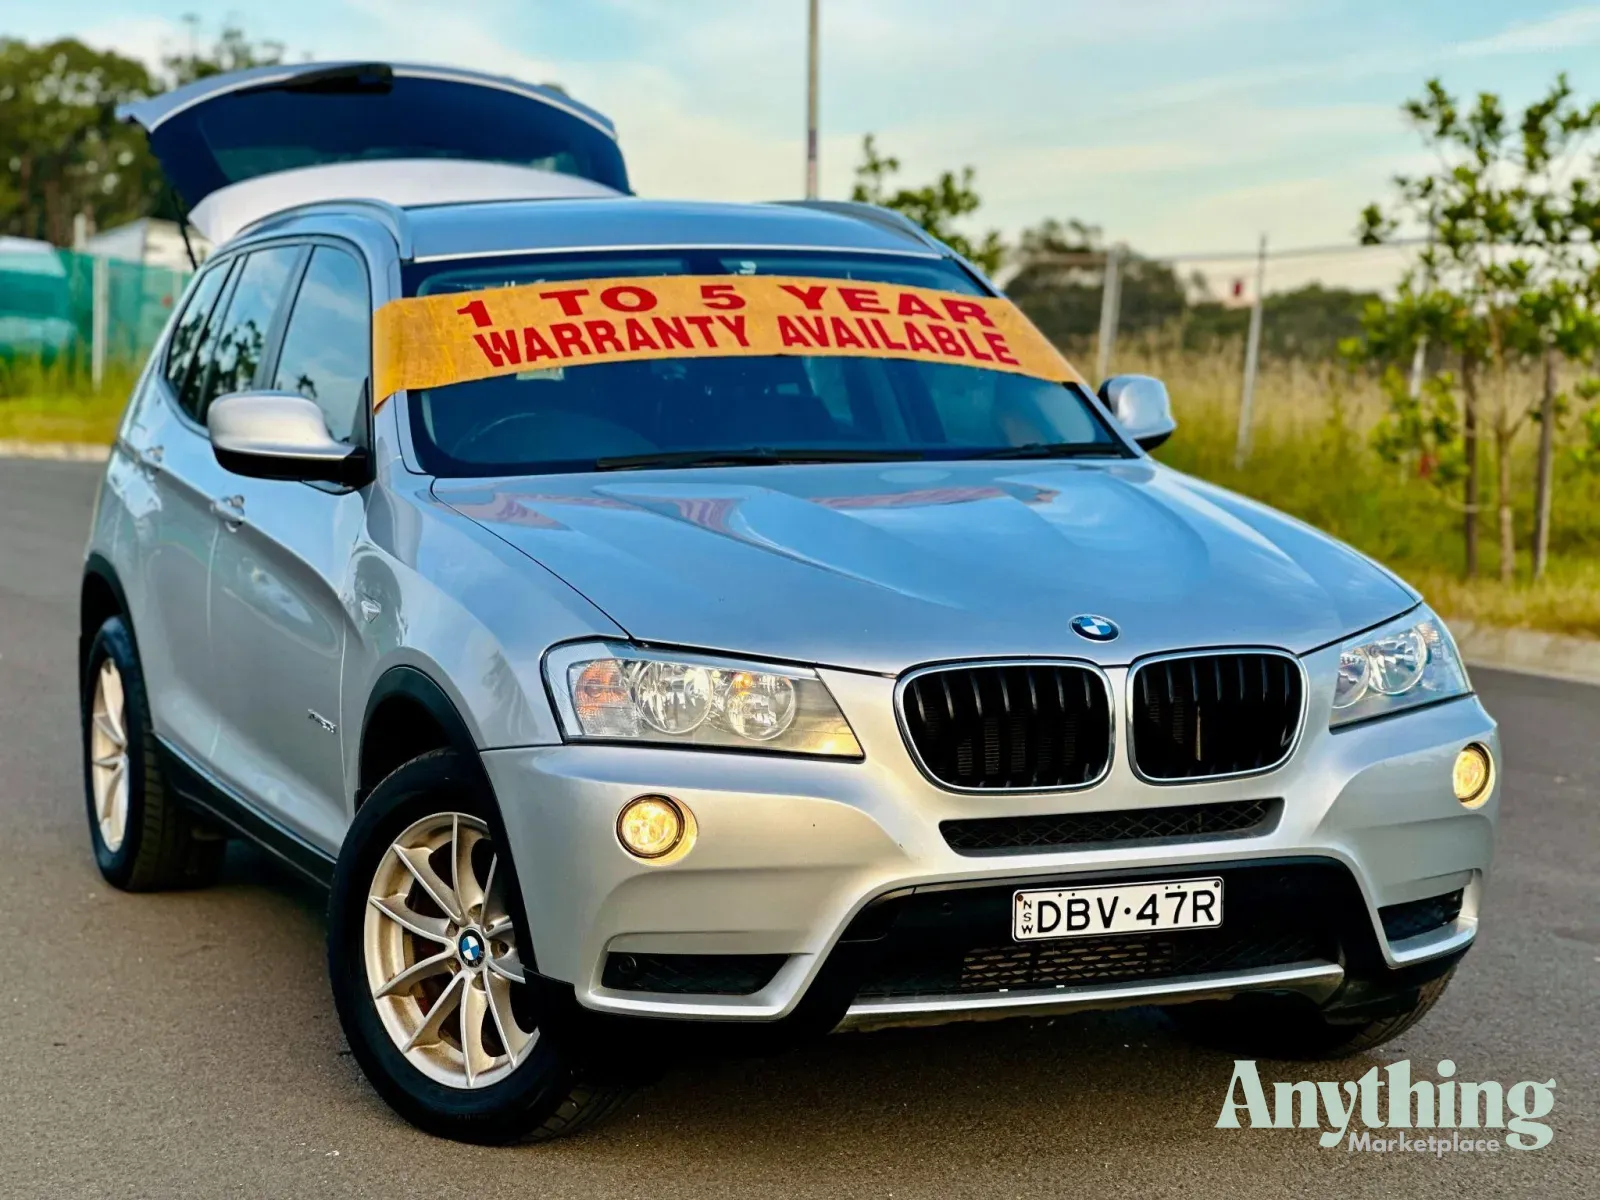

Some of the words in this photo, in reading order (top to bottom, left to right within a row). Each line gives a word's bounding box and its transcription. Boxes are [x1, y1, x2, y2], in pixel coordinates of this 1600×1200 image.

[456, 299, 493, 328] 1
[539, 286, 658, 317] TO
[699, 284, 746, 310] 5
[777, 285, 996, 328] YEAR
[473, 315, 751, 367] WARRANTY
[777, 315, 1020, 366] AVAILABLE
